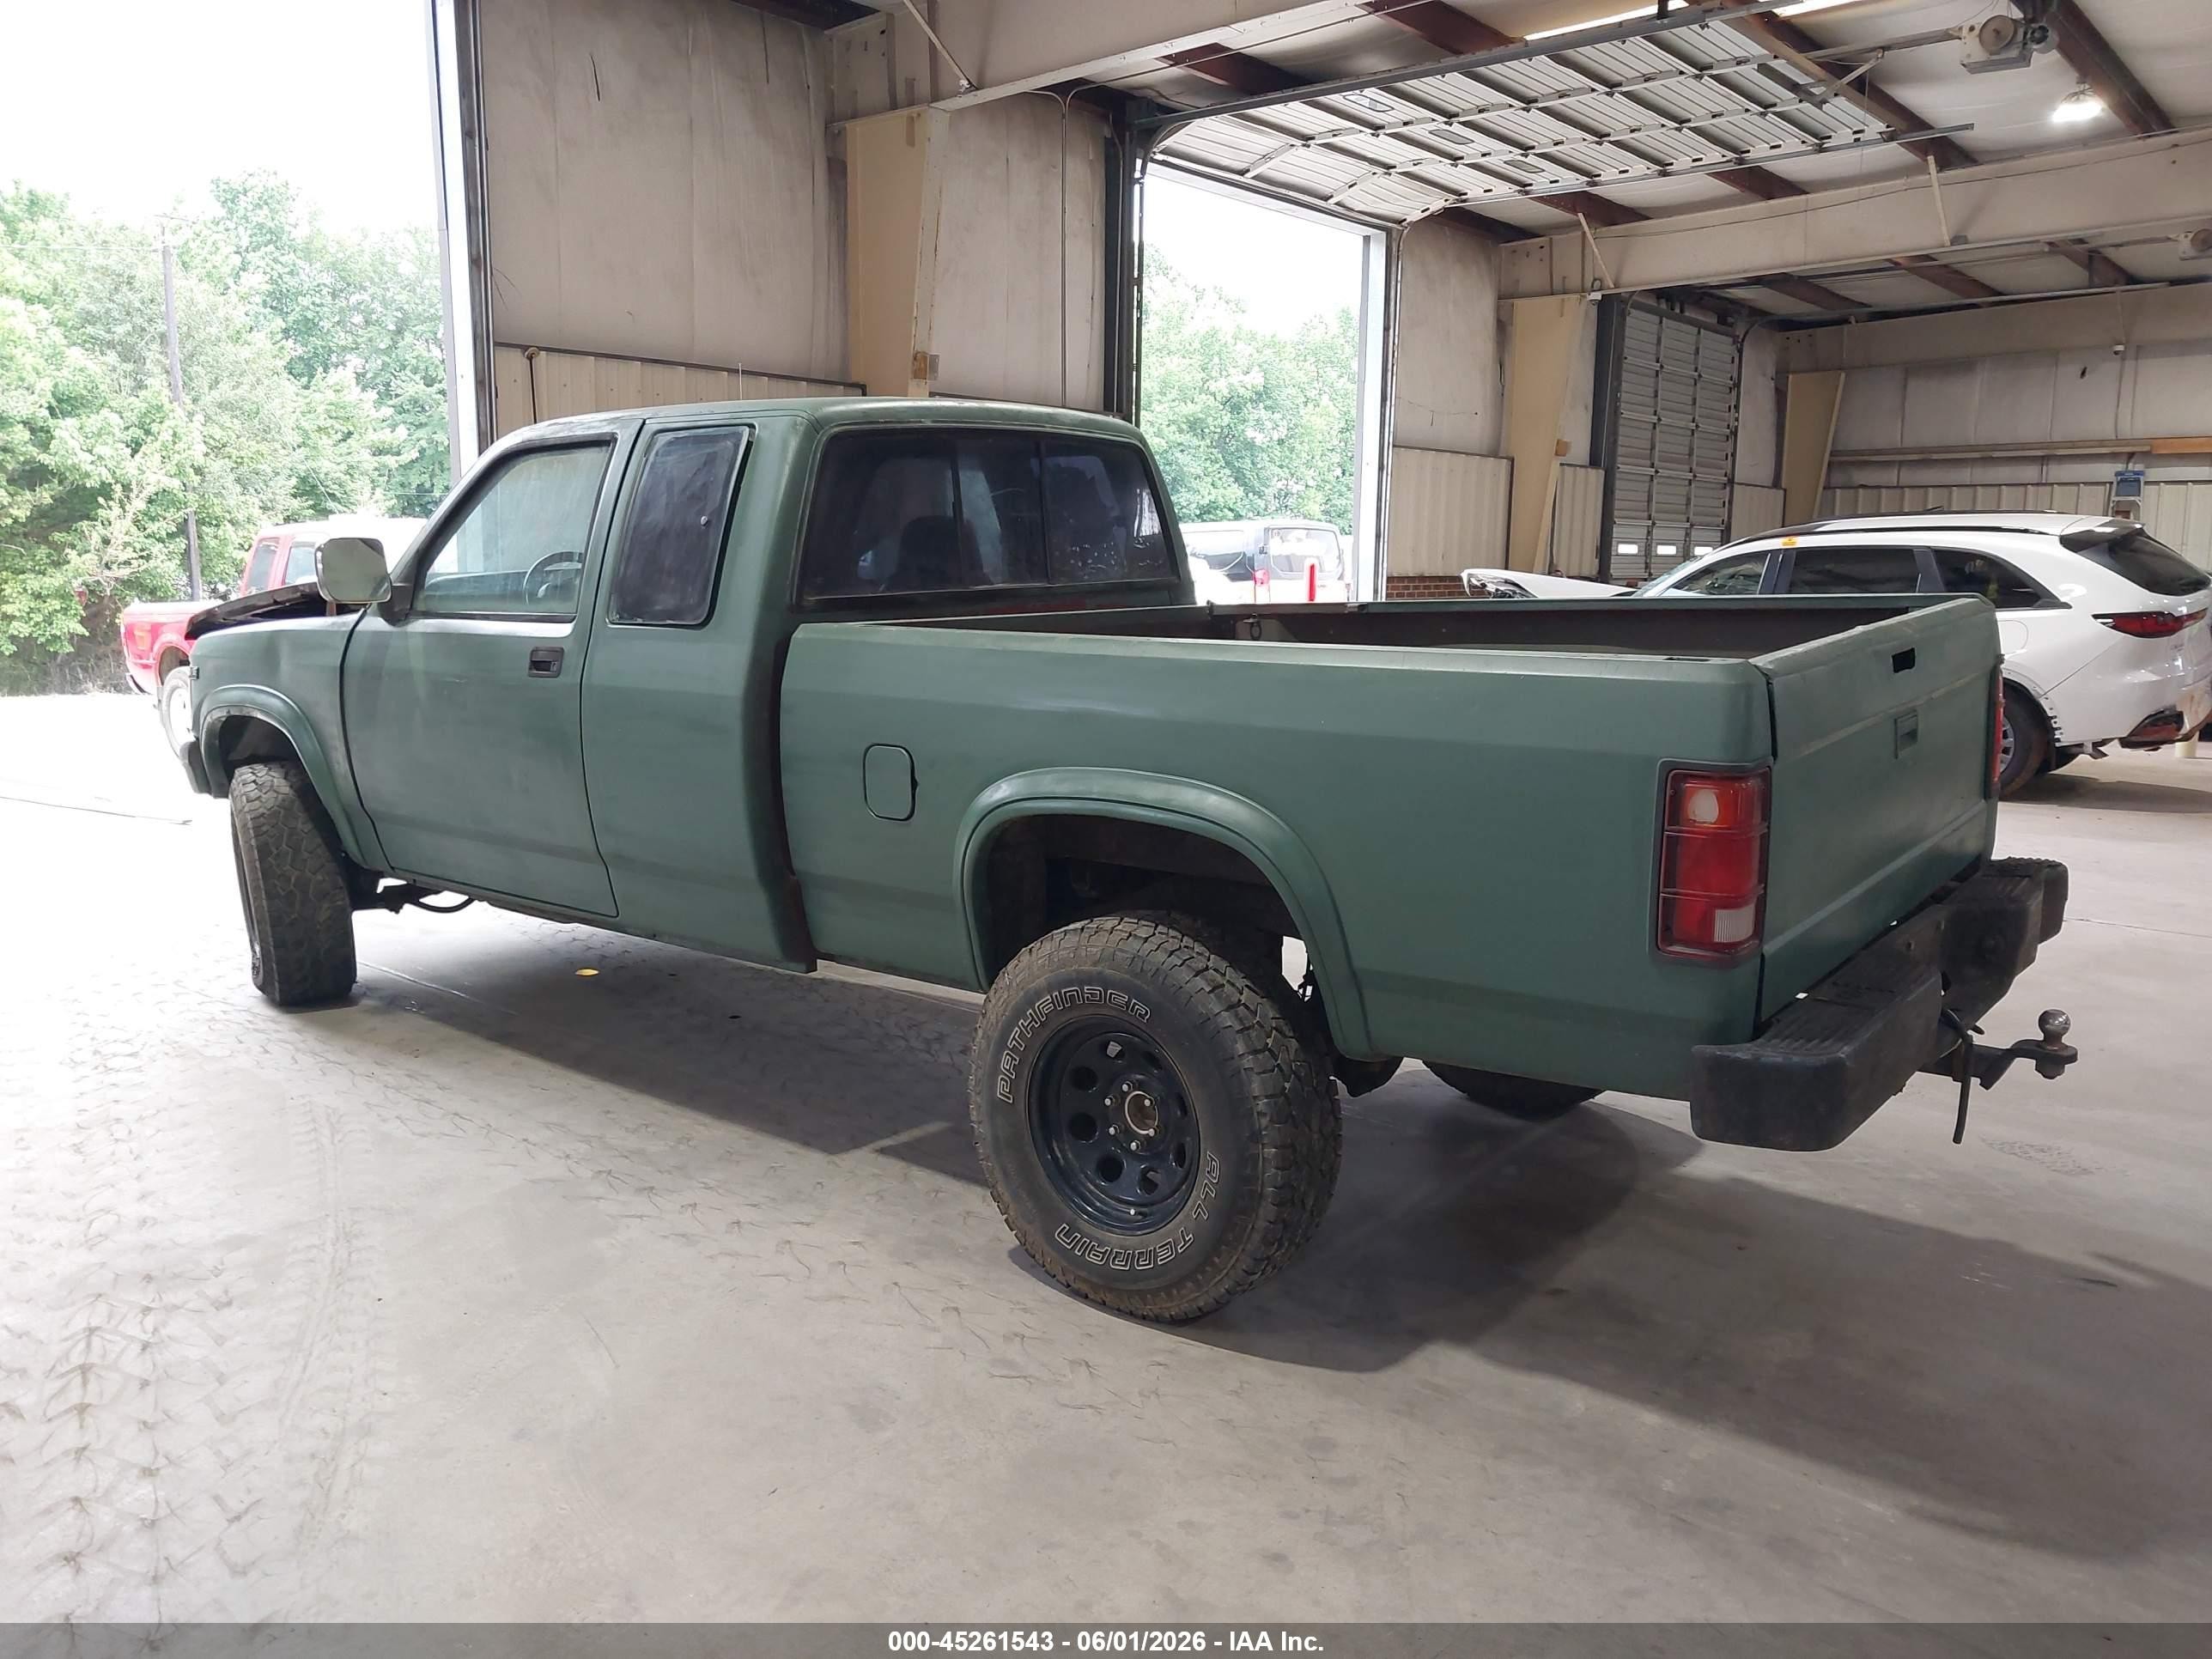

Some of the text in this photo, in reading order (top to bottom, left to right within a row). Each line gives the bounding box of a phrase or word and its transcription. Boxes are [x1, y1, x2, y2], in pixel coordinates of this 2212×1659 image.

[996, 985, 1152, 1104] PATHFINDER
[1054, 1152, 1222, 1271] ALL TERRAIN
